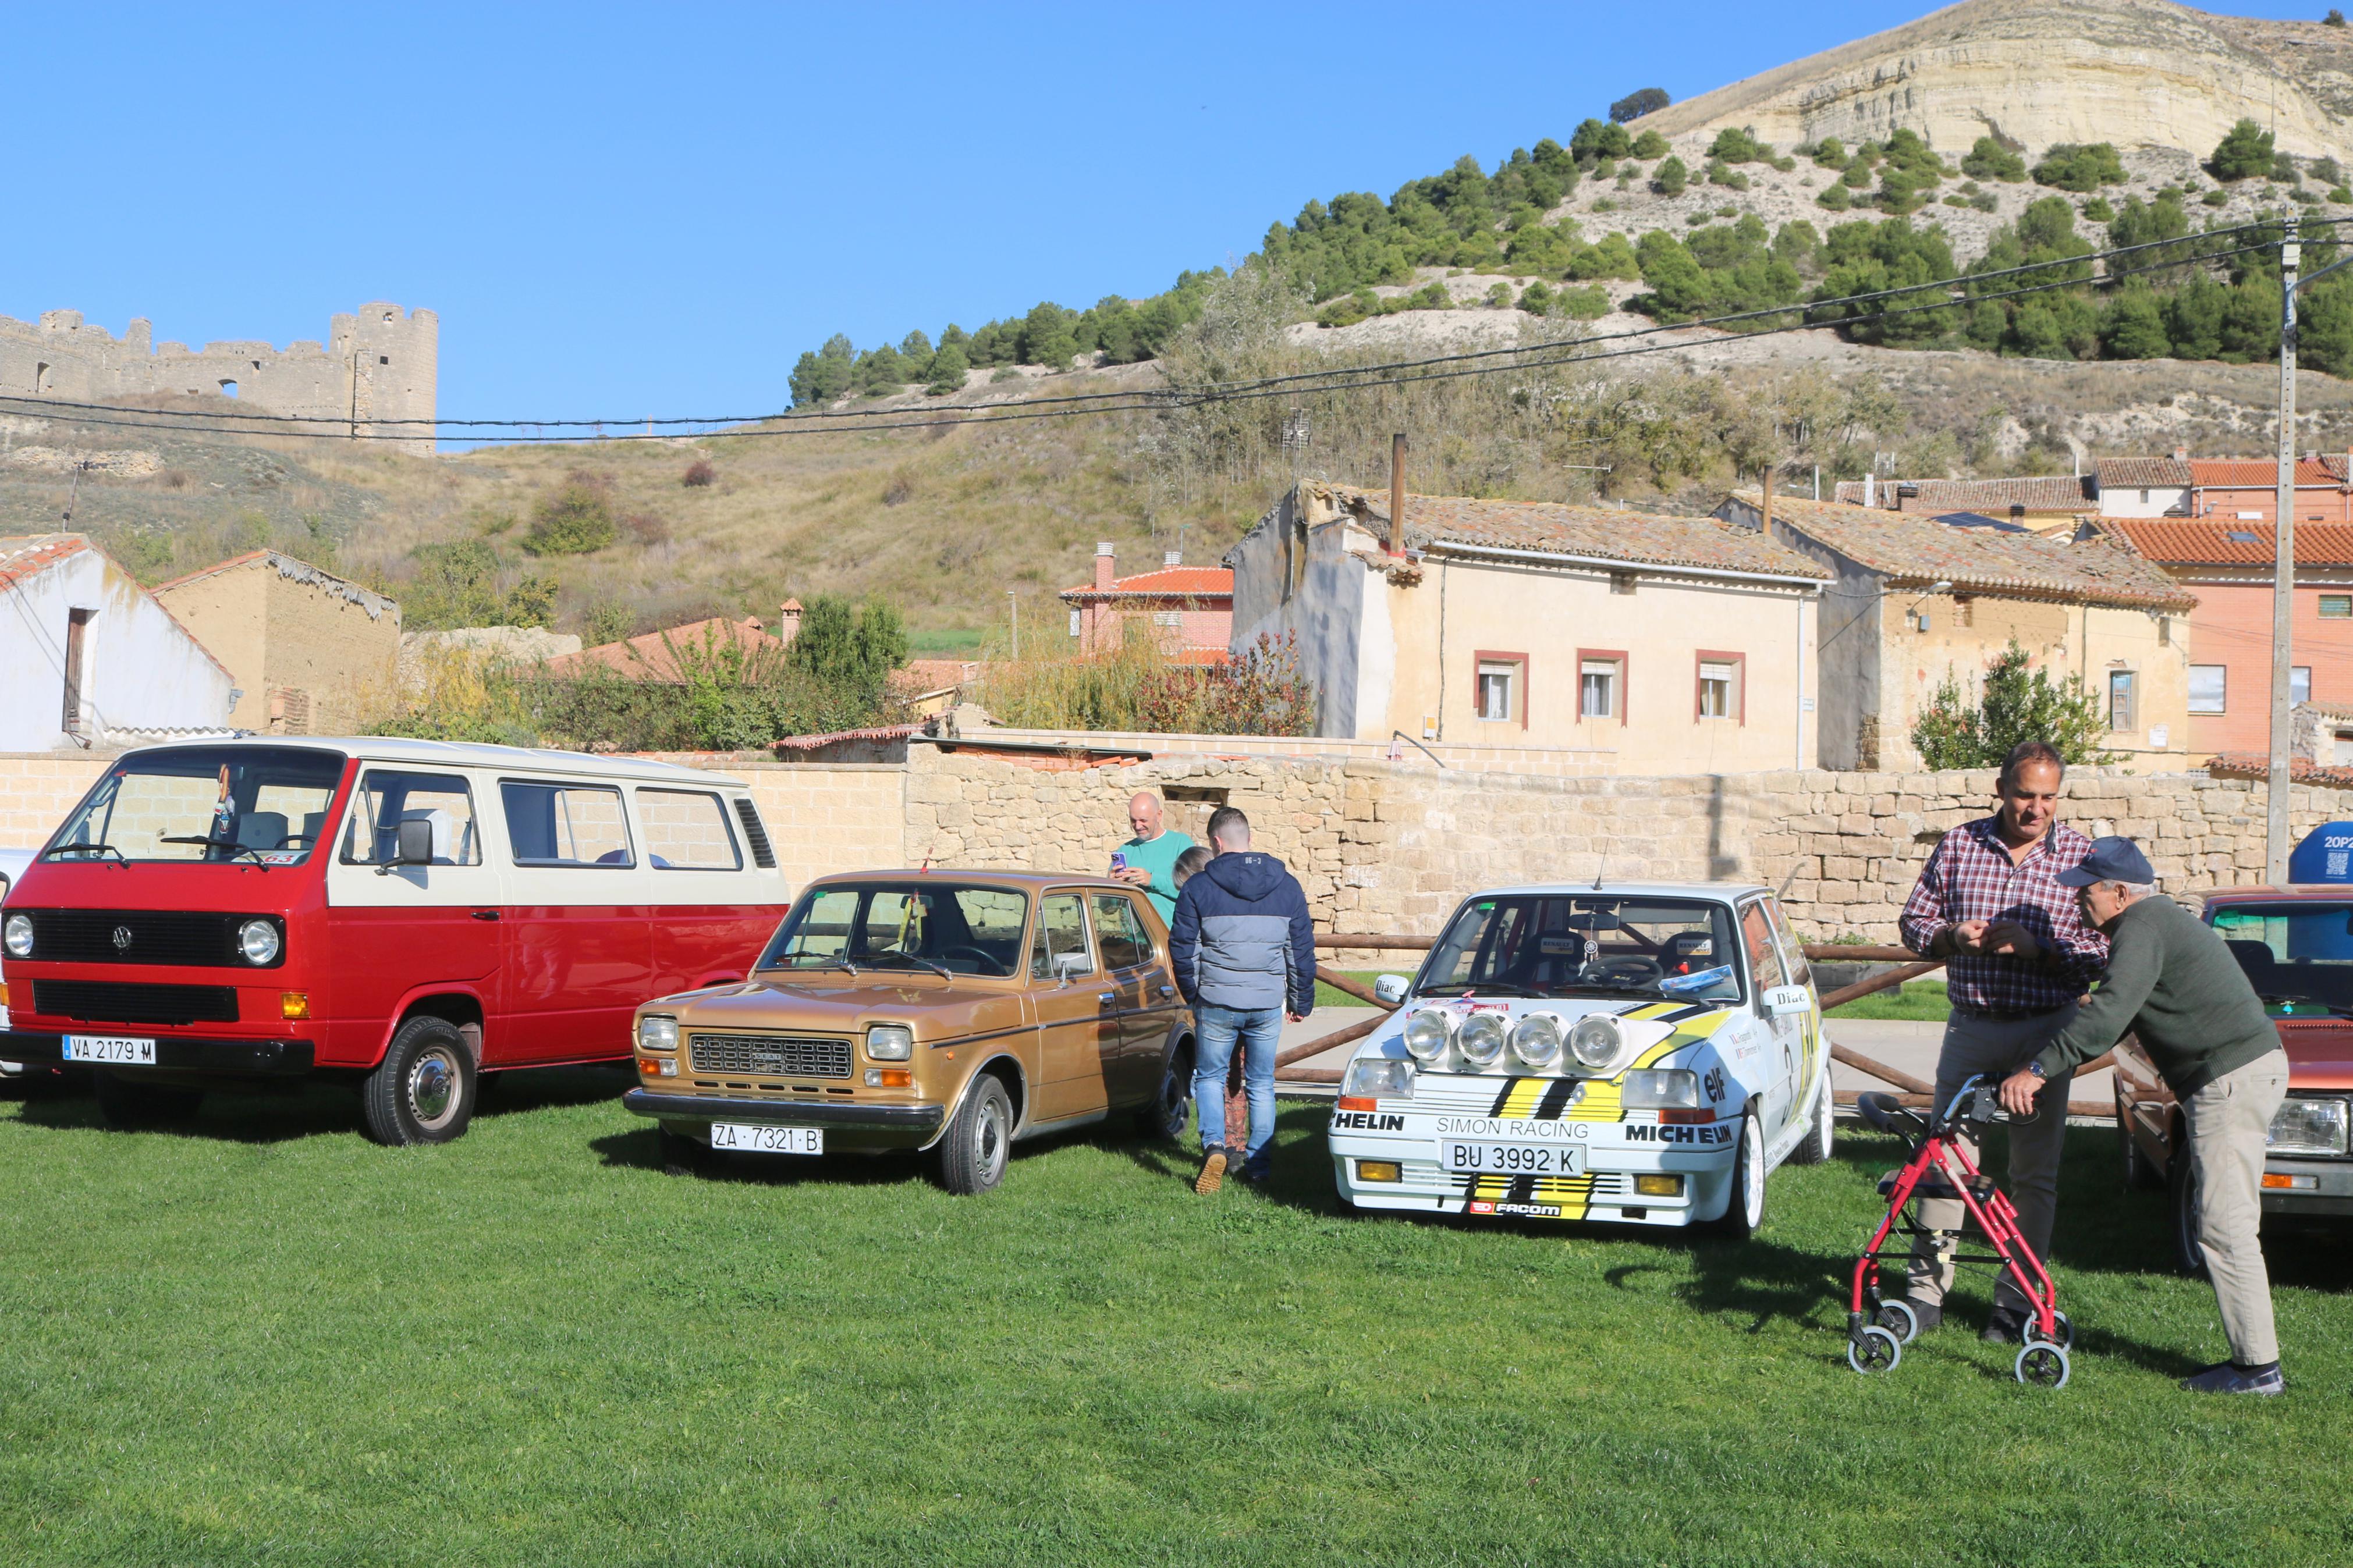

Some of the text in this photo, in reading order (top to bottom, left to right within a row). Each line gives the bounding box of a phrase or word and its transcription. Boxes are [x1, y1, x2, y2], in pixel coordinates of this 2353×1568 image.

[1376, 980, 1395, 993] Diac
[1777, 992, 1805, 1005] Diac
[73, 1039, 151, 1061] VA 2179 M
[1704, 1068, 1726, 1103] elf
[715, 1125, 817, 1151] ZA 7321 B
[1437, 1118, 1588, 1138] SIMON RACING
[1626, 1125, 1733, 1144] MICHELIN
[1454, 1145, 1574, 1172] BU 3992 K
[1496, 1203, 1560, 1216] FACOM
